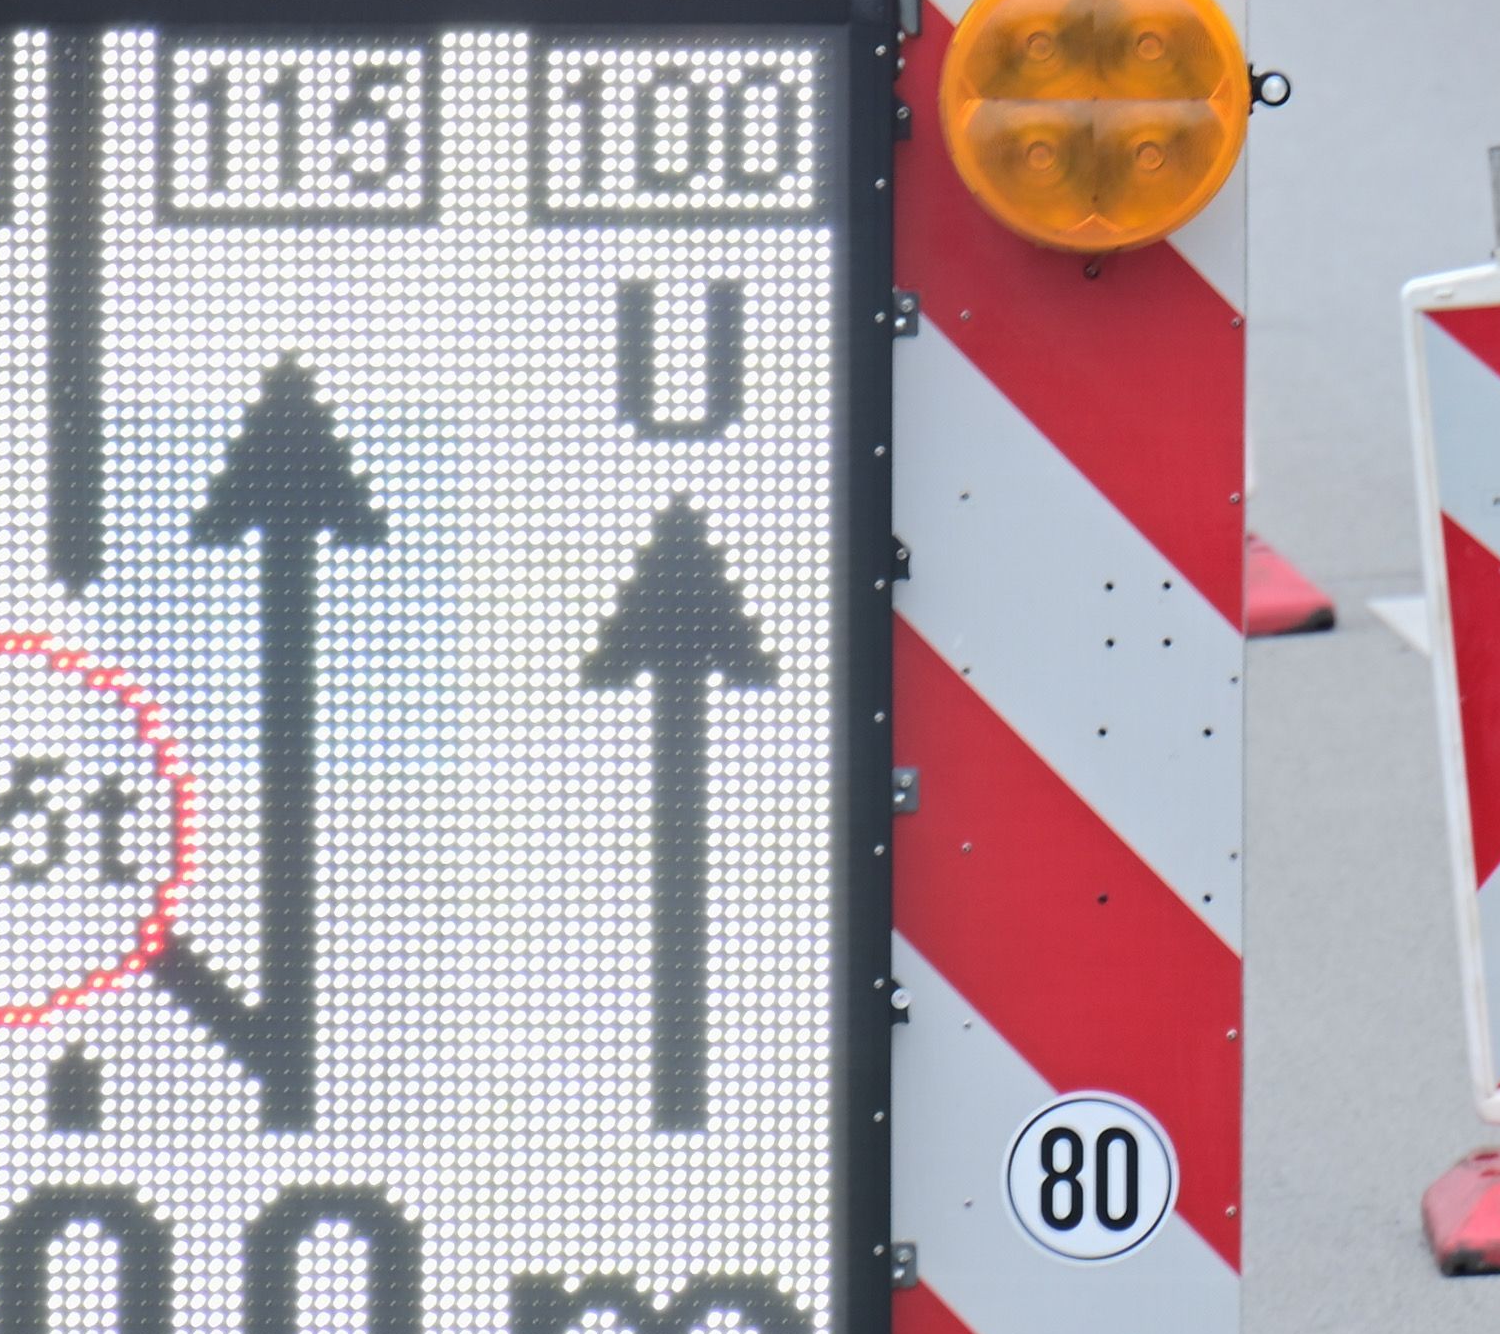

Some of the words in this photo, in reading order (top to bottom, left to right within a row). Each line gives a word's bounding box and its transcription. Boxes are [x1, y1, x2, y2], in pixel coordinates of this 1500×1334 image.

[191, 66, 408, 191] 115
[565, 66, 798, 191] 100
[619, 279, 743, 442] U
[1040, 1126, 1139, 1231] 80
